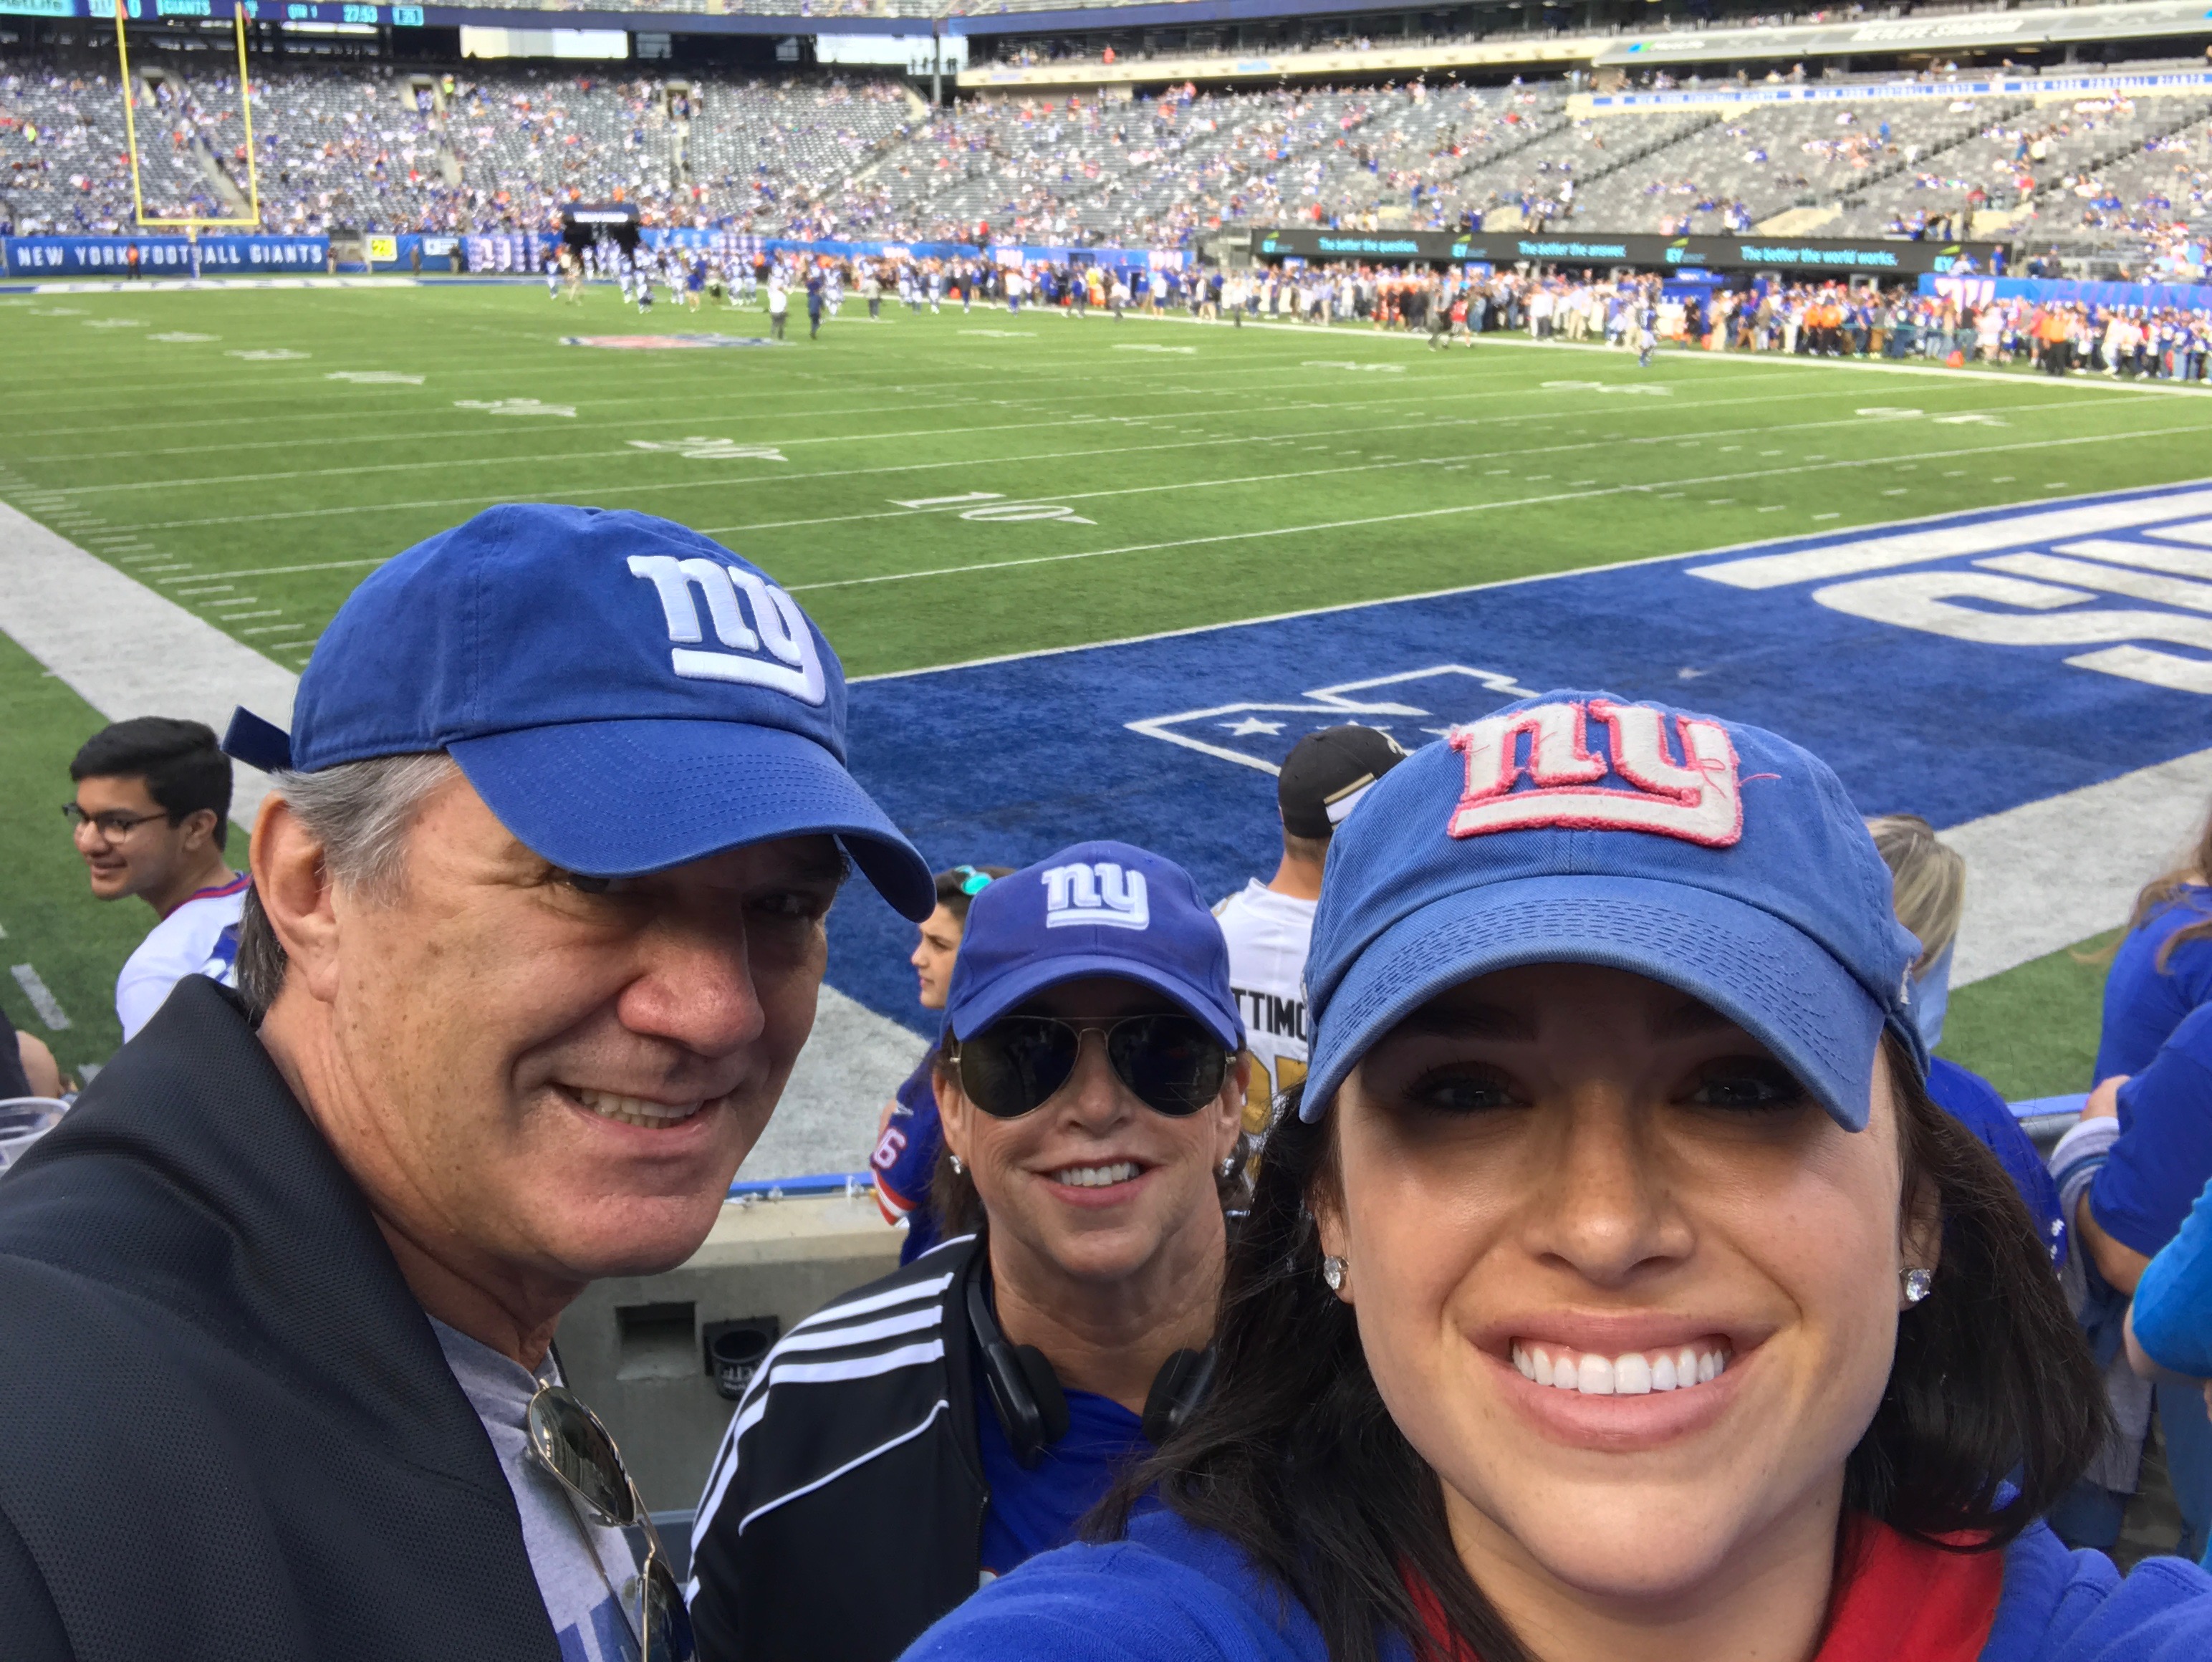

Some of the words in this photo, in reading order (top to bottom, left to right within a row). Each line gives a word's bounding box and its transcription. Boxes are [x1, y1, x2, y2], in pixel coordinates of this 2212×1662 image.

[17, 246, 63, 266] NEW
[74, 246, 128, 266] YORK
[249, 244, 322, 264] GIANTS
[1741, 245, 1762, 261] The
[1763, 246, 1799, 263] better
[1800, 246, 1821, 264] the
[1822, 248, 1857, 265] world
[873, 1127, 908, 1170] 6
